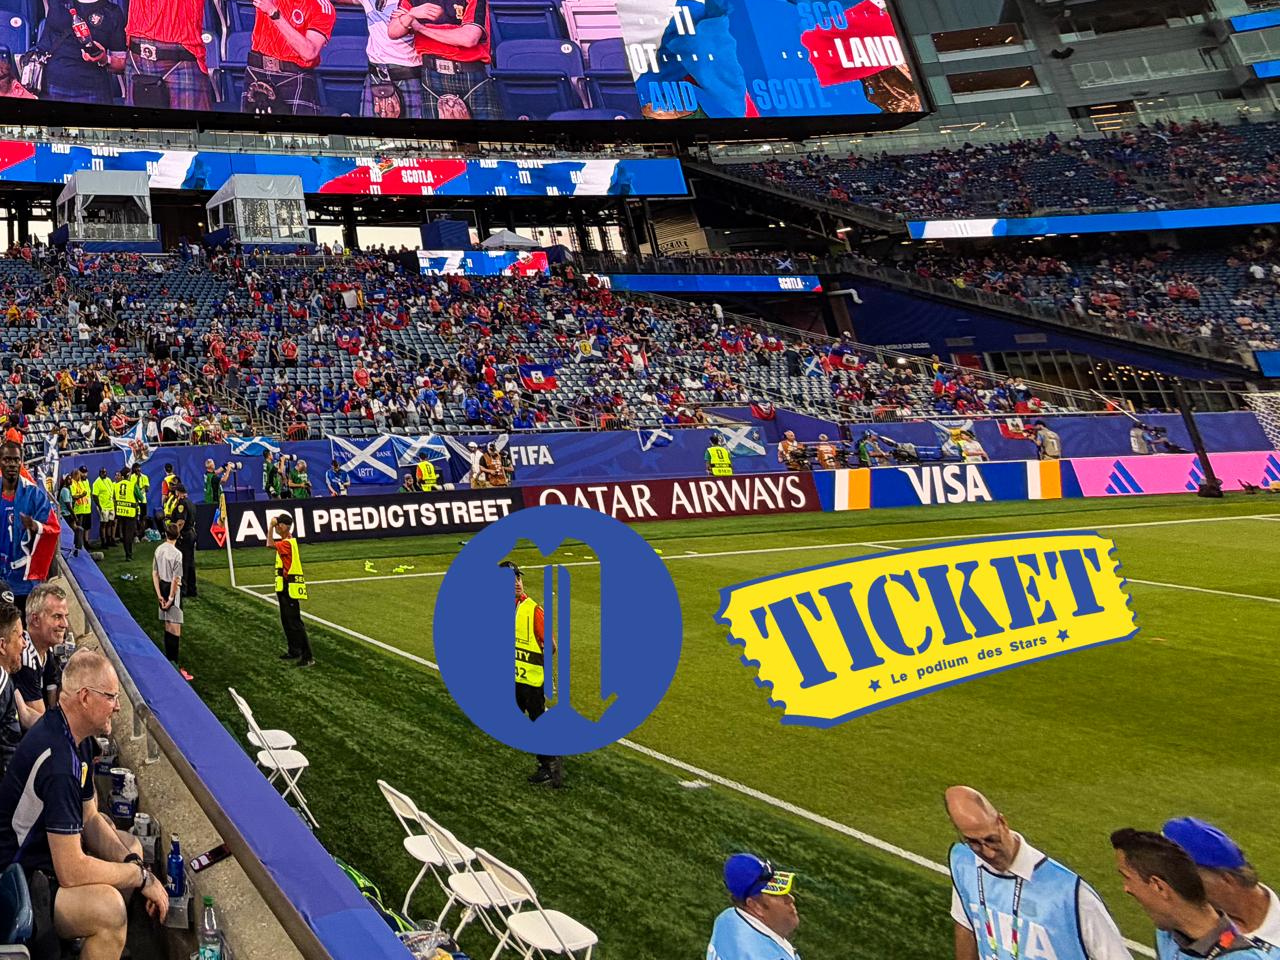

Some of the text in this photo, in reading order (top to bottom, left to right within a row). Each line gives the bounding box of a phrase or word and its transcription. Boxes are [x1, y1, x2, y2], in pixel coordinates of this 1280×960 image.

[834, 35, 905, 69] LAND
[509, 445, 555, 467] FIFA
[671, 475, 807, 515] AIRWAYS
[899, 463, 993, 505] VISA
[312, 498, 513, 533] PREDICTSTREET
